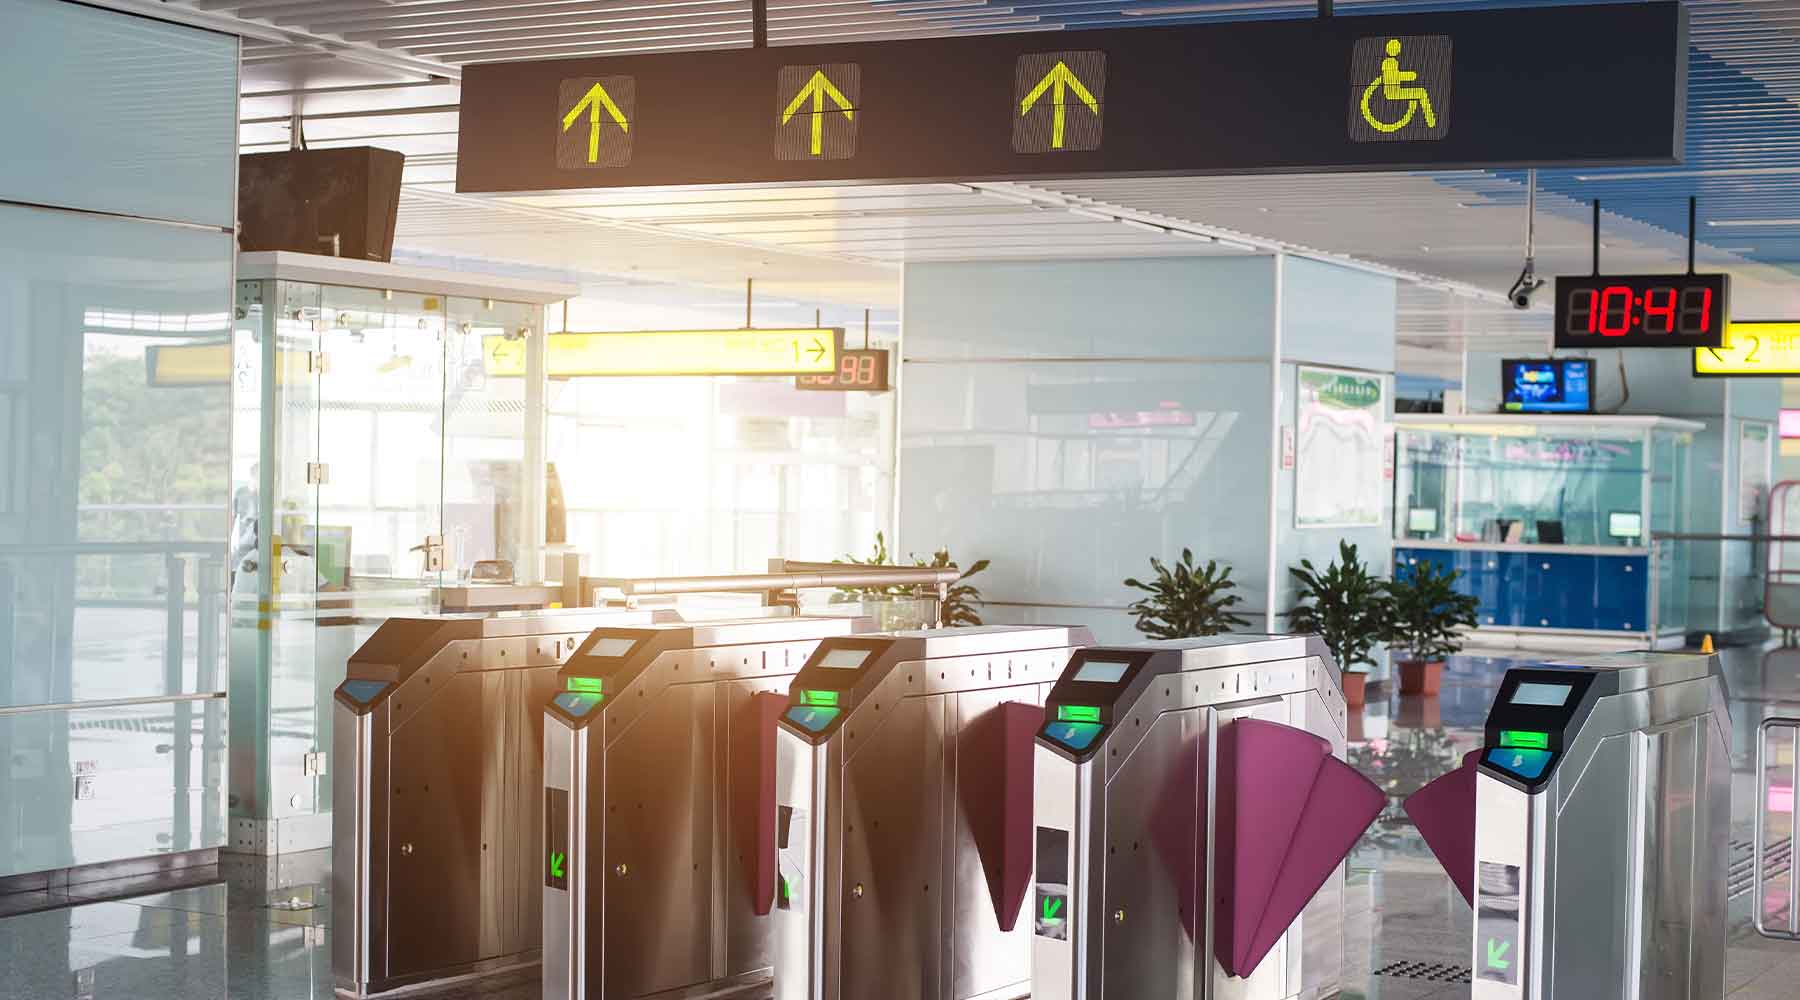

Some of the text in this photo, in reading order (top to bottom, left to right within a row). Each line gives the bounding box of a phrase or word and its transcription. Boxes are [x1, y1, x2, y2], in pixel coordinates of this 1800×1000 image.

[1588, 286, 1712, 337] 10:41
[792, 337, 799, 368] 1
[1743, 335, 1761, 363] 2
